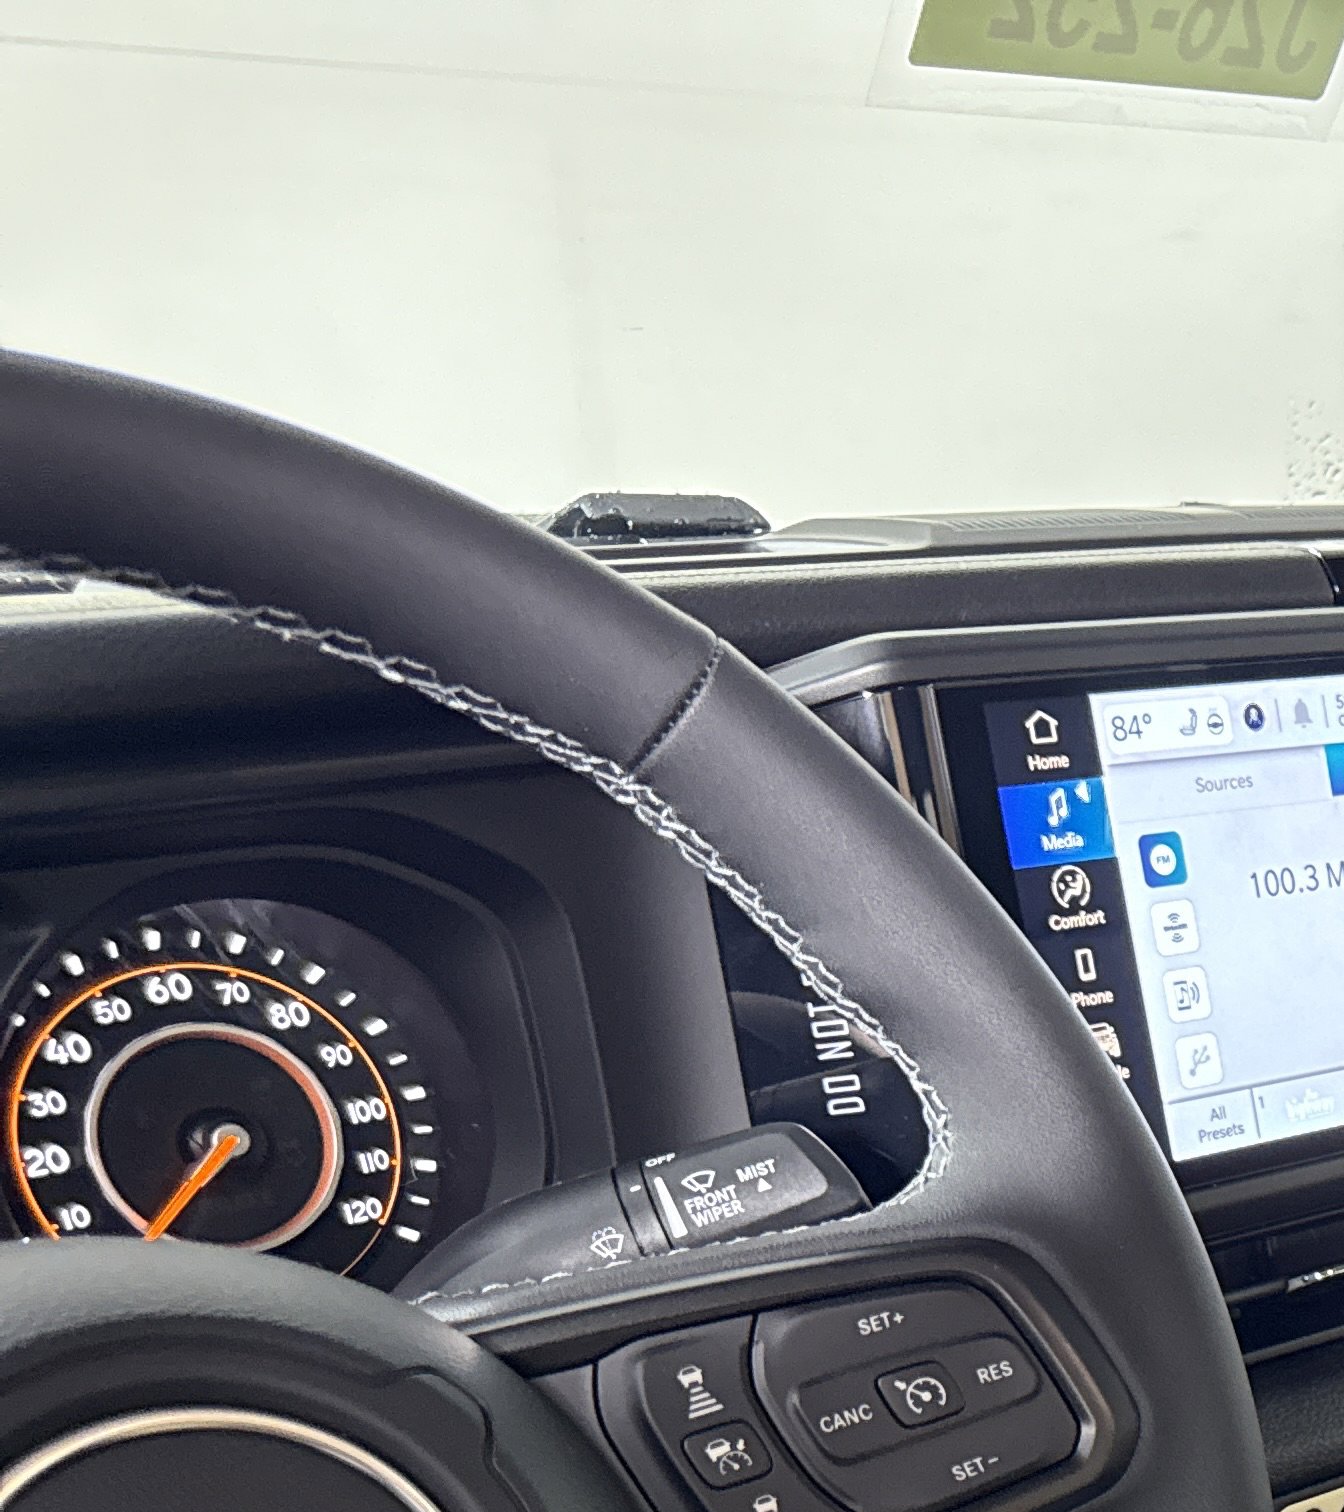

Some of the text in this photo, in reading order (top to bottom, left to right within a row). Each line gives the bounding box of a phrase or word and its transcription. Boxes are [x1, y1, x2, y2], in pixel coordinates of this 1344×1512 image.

[1111, 713, 1152, 742] 84°
[1026, 754, 1070, 772] Home
[1195, 775, 1254, 793] Sources
[1040, 831, 1085, 851] Media
[1156, 854, 1171, 865] FM
[1250, 864, 1320, 898] 100.3
[1048, 909, 1107, 931] Comfort
[146, 972, 195, 1005] 60
[214, 980, 252, 1008] 70
[1069, 990, 1114, 1007] Phone
[92, 998, 132, 1026] 50
[269, 1001, 311, 1030] 80
[45, 1037, 92, 1065] 40
[319, 1044, 353, 1069] 90
[806, 1001, 866, 1117] DO NOT
[25, 1091, 68, 1118] 30
[346, 1098, 387, 1124] 100
[1210, 1106, 1227, 1122] All
[1198, 1124, 1245, 1143] Presets
[23, 1145, 71, 1178] 20
[356, 1149, 391, 1174] 110
[645, 1152, 676, 1168] OFF
[735, 1158, 776, 1183] MIST
[341, 1197, 384, 1225] 120
[683, 1184, 737, 1214] FRONT
[59, 1203, 92, 1232] 10
[690, 1199, 746, 1228] WIPER
[976, 1360, 1014, 1385] RES
[819, 1404, 874, 1434] CANC
